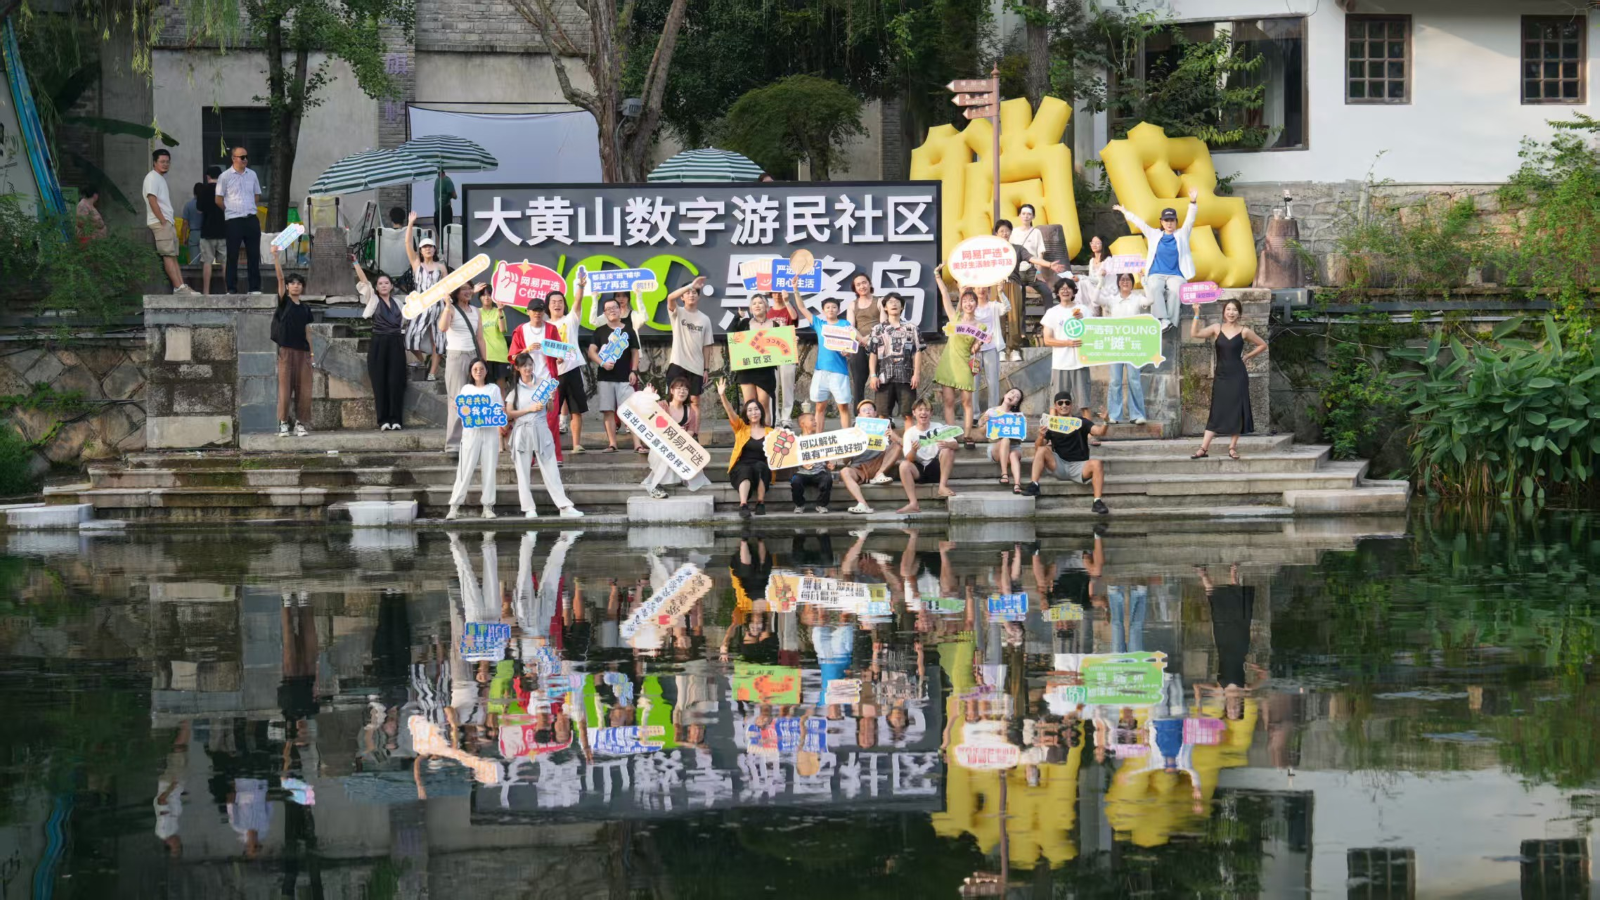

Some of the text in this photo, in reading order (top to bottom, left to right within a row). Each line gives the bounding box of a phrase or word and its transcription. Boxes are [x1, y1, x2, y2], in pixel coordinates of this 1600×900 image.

[474, 194, 934, 247] 大黄山数字游民社区
[962, 247, 1002, 260] 网易严选
[520, 276, 560, 291] 网易严选
[593, 280, 629, 290] 买了再走
[776, 278, 814, 288] 用心生活
[1085, 325, 1157, 335] 严选有YOUNG
[472, 406, 502, 416] 我们在
[622, 409, 691, 474] 活出自己喜欢的样子
[663, 426, 704, 467] 网易严选
[800, 435, 838, 450] 何以解忧
